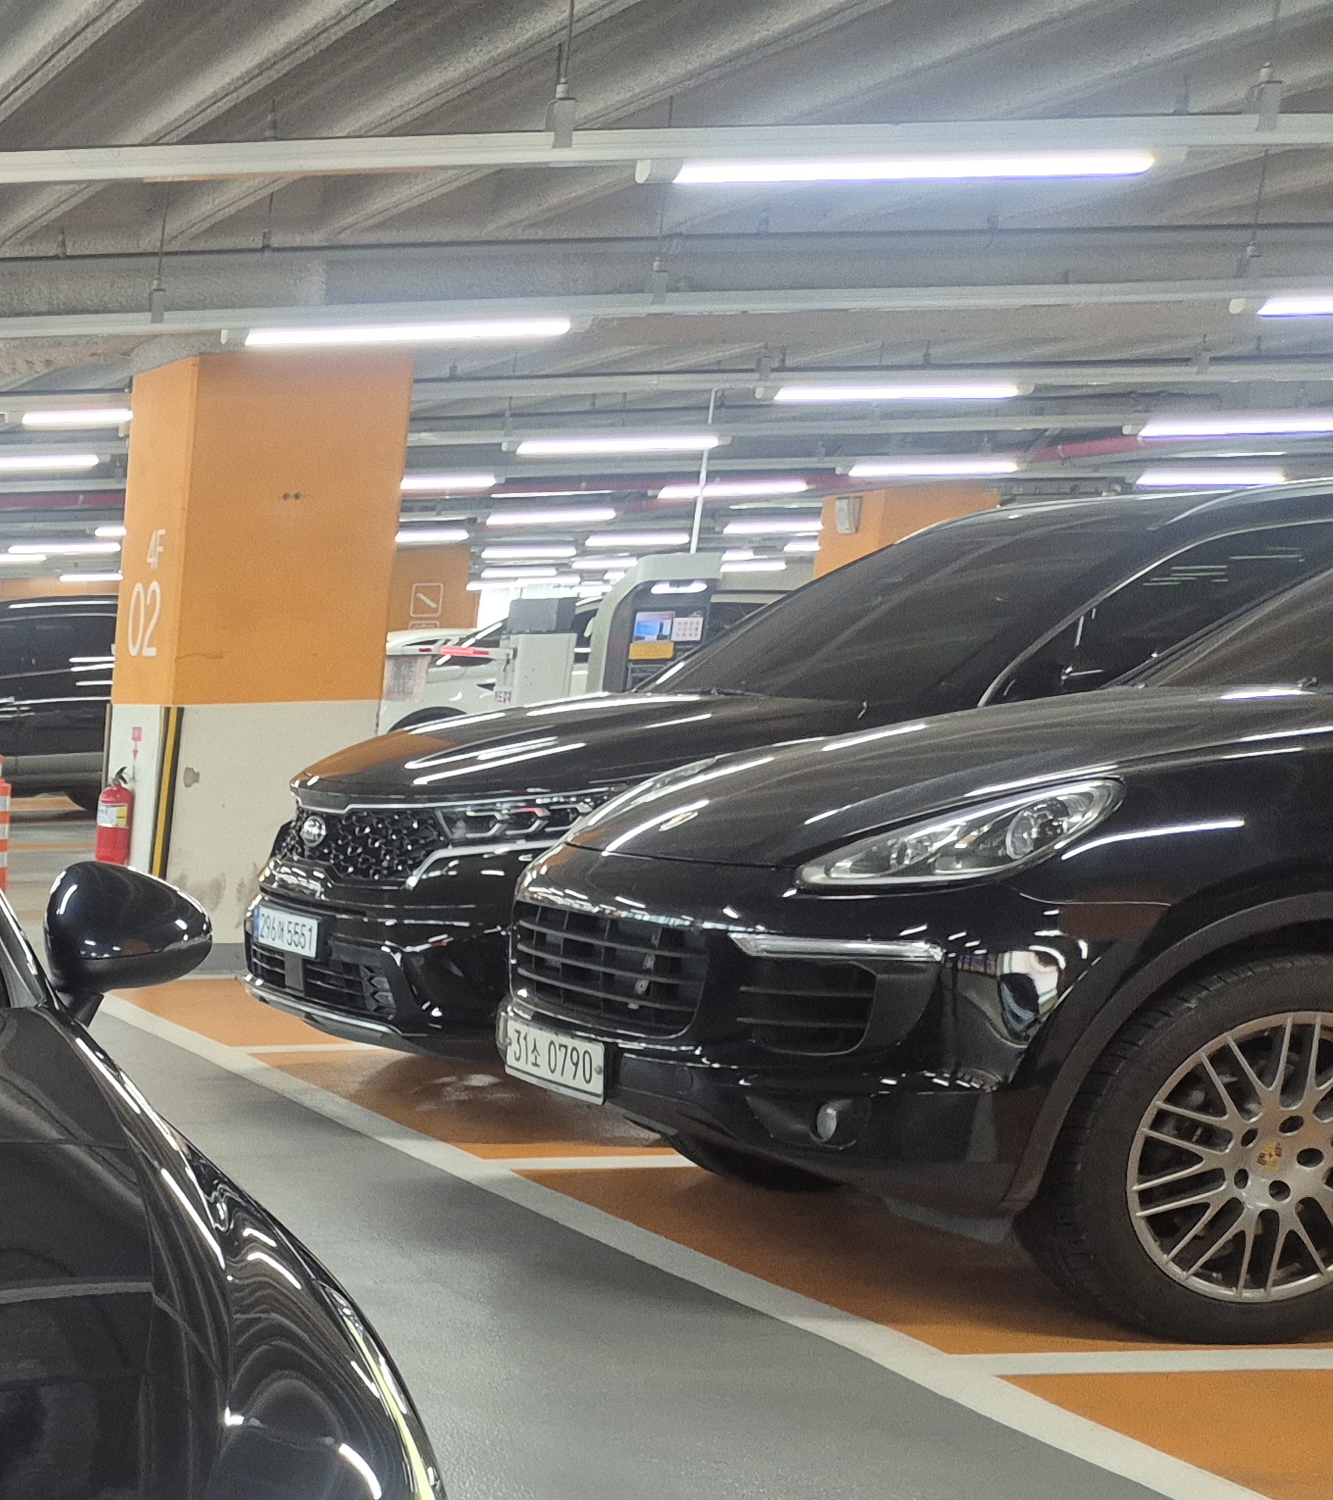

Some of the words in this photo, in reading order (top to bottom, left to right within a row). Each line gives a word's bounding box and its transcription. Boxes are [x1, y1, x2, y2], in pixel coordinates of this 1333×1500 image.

[147, 529, 166, 569] 4F
[128, 581, 161, 657] 02
[286, 921, 313, 951] 5551
[547, 1040, 593, 1085] 0790
